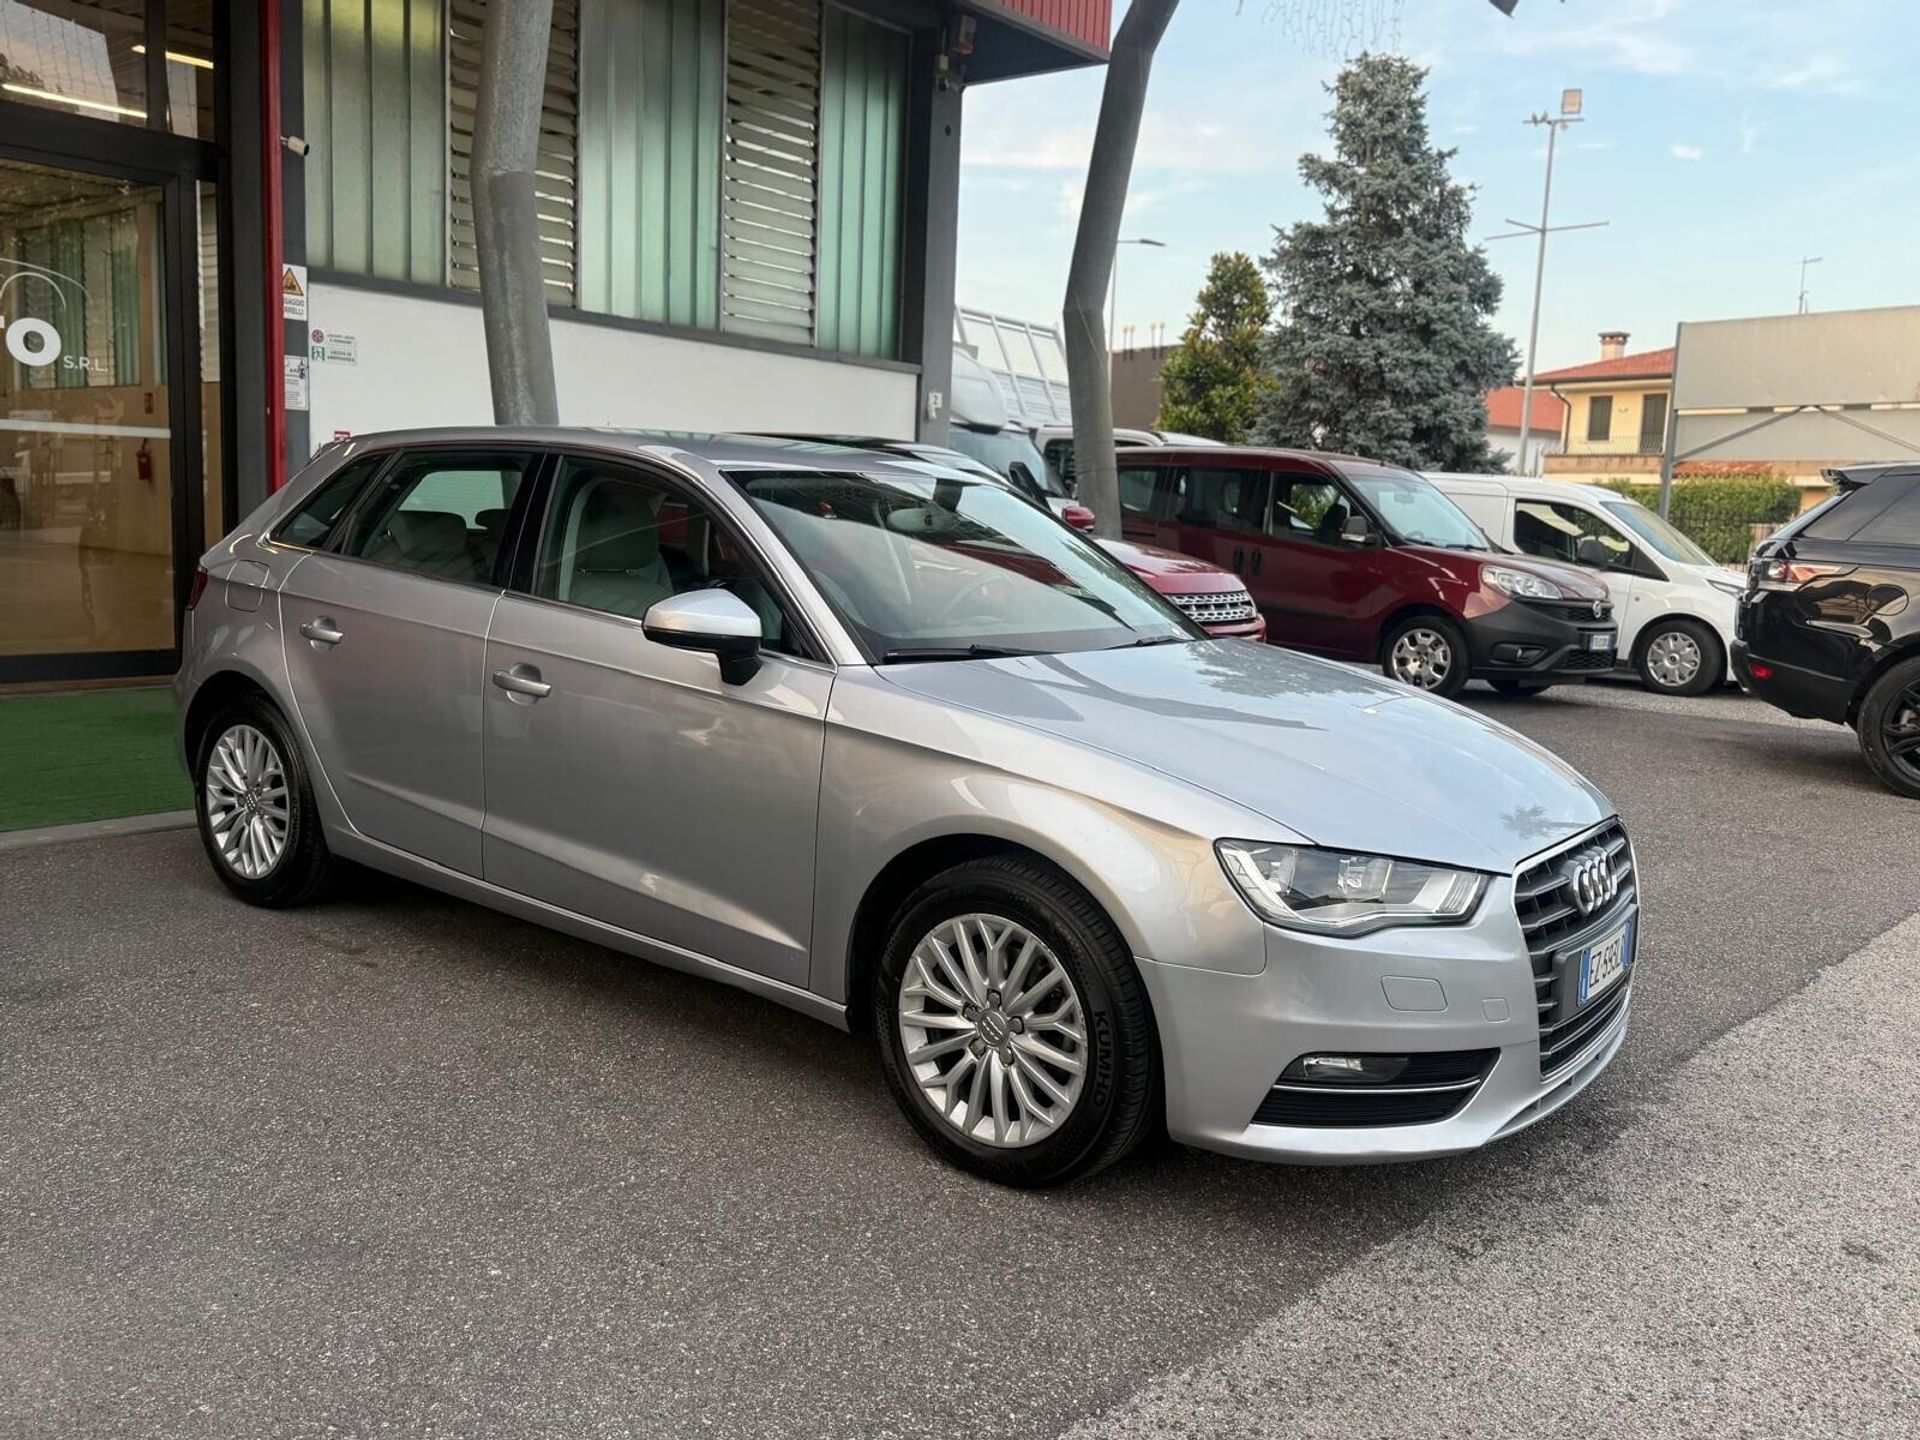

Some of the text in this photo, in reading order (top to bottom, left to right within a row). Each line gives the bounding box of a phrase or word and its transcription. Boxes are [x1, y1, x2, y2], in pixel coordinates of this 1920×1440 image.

[0, 315, 108, 372] O S.R.L.
[1094, 1011, 1112, 1106] KUMHO
